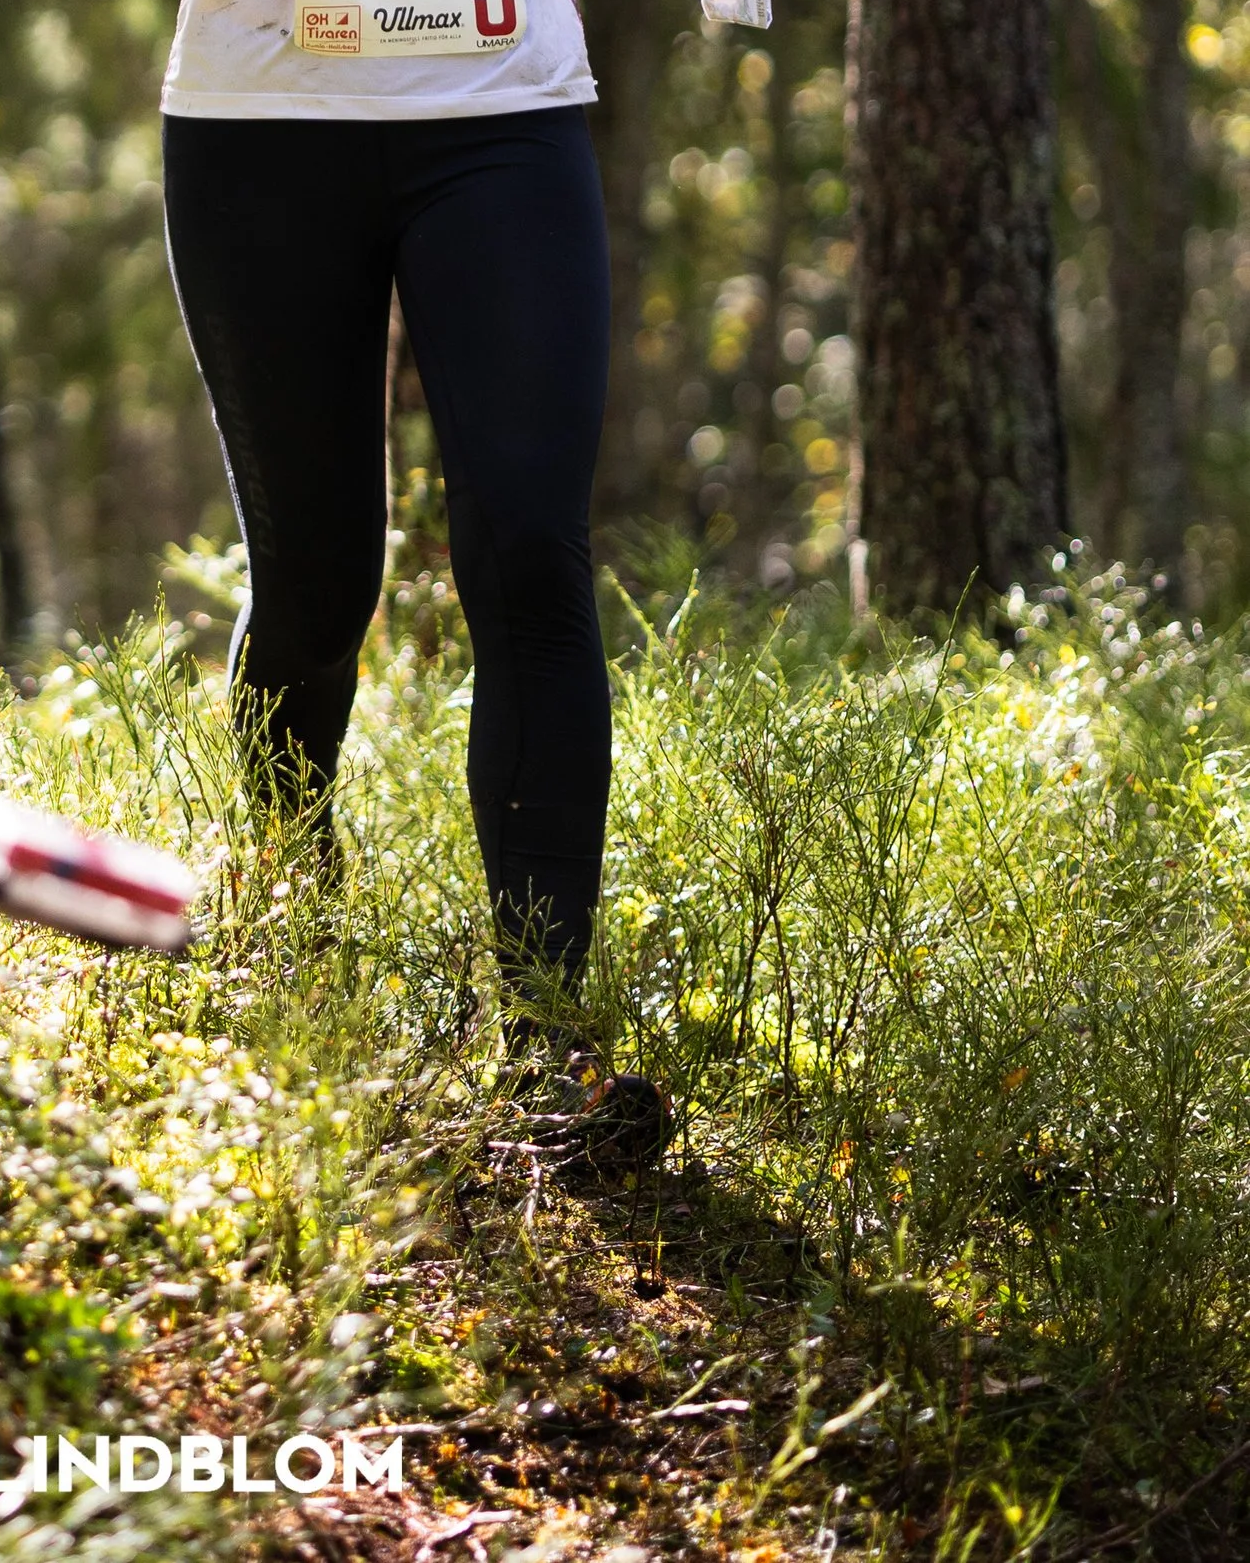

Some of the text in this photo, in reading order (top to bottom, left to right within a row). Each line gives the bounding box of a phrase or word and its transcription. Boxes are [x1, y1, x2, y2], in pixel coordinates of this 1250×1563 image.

[374, 6, 463, 33] Ullmax
[306, 27, 358, 39] Tisaren
[476, 37, 516, 48] UMARA
